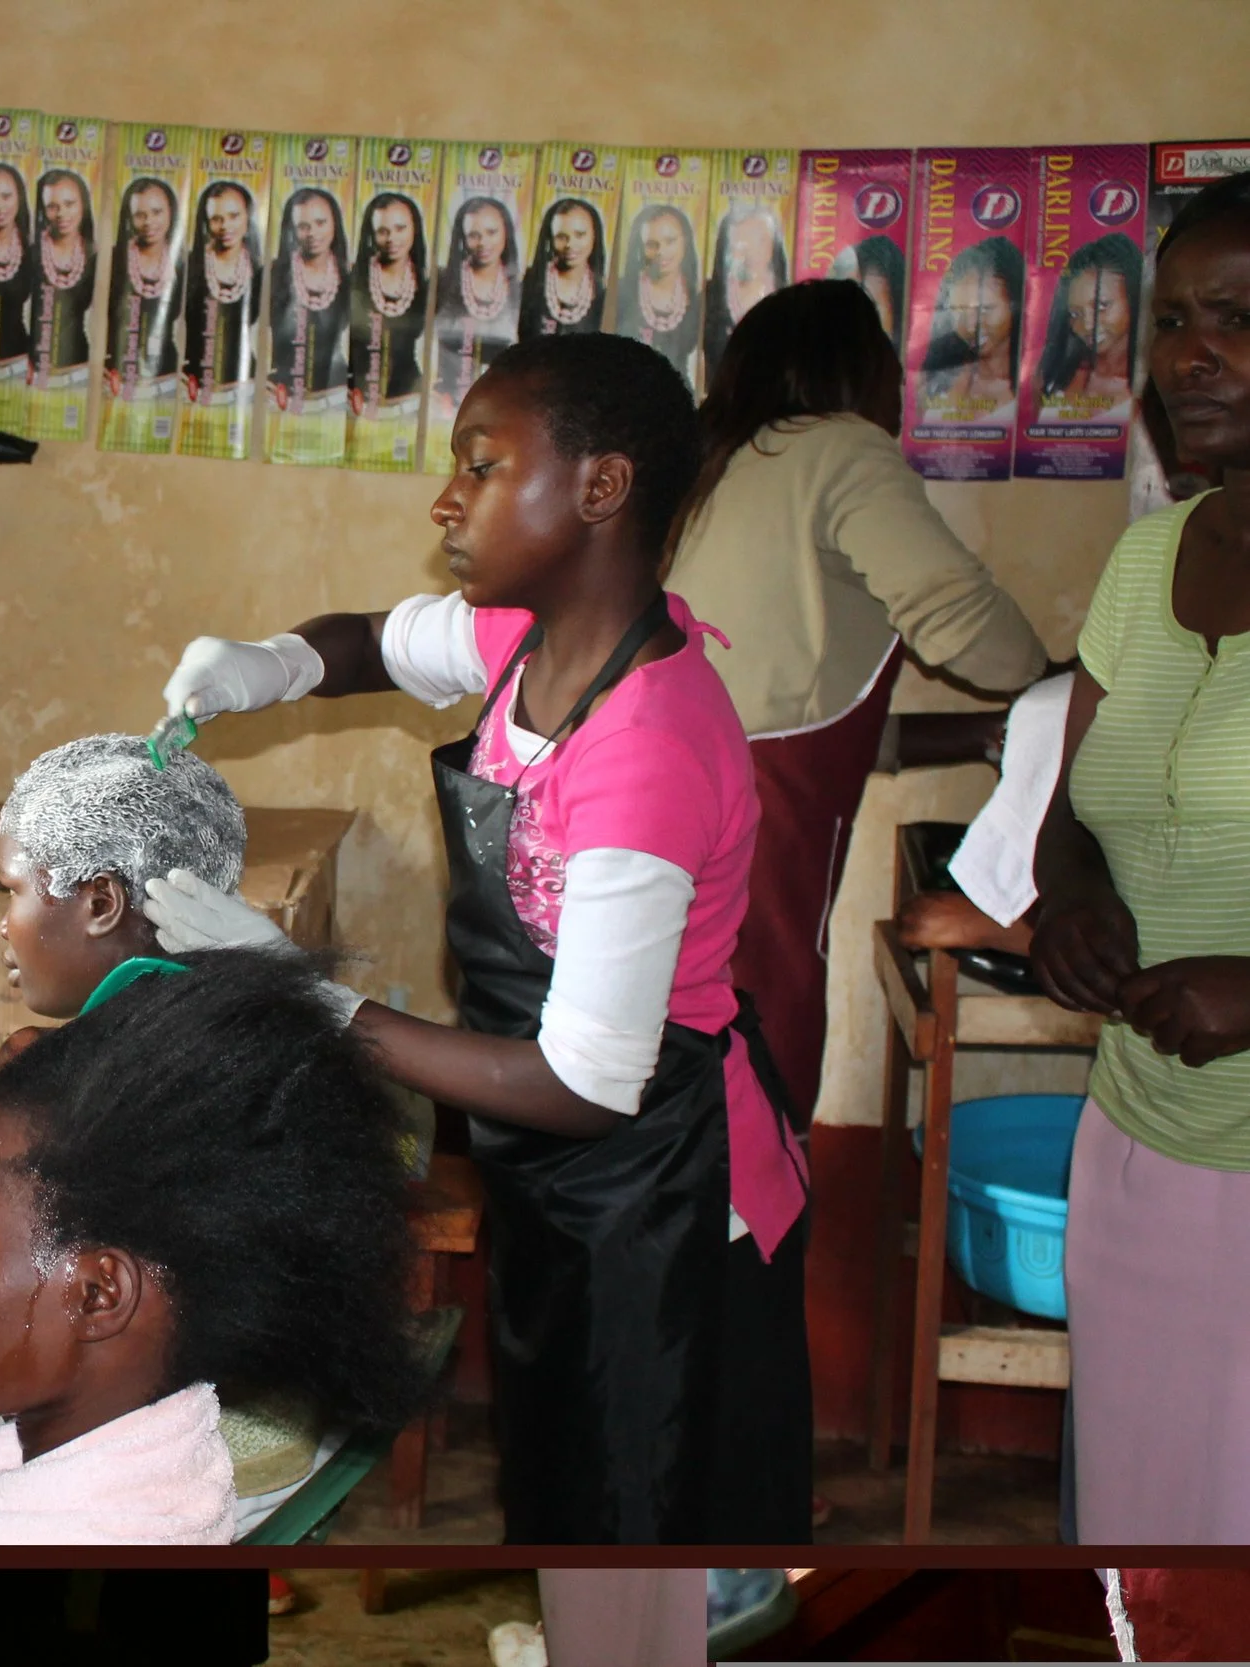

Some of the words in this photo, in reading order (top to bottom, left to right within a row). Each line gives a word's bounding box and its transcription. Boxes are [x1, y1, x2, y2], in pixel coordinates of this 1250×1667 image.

[200, 157, 264, 173] DARLING
[283, 164, 348, 179] DARLING
[1167, 157, 1183, 171] D
[365, 167, 431, 185] DARLING
[456, 172, 522, 189] DARLING
[547, 172, 615, 191] DARLING
[809, 157, 840, 269] DARLING
[926, 159, 957, 272] DARLING
[1043, 155, 1073, 268] DARLING
